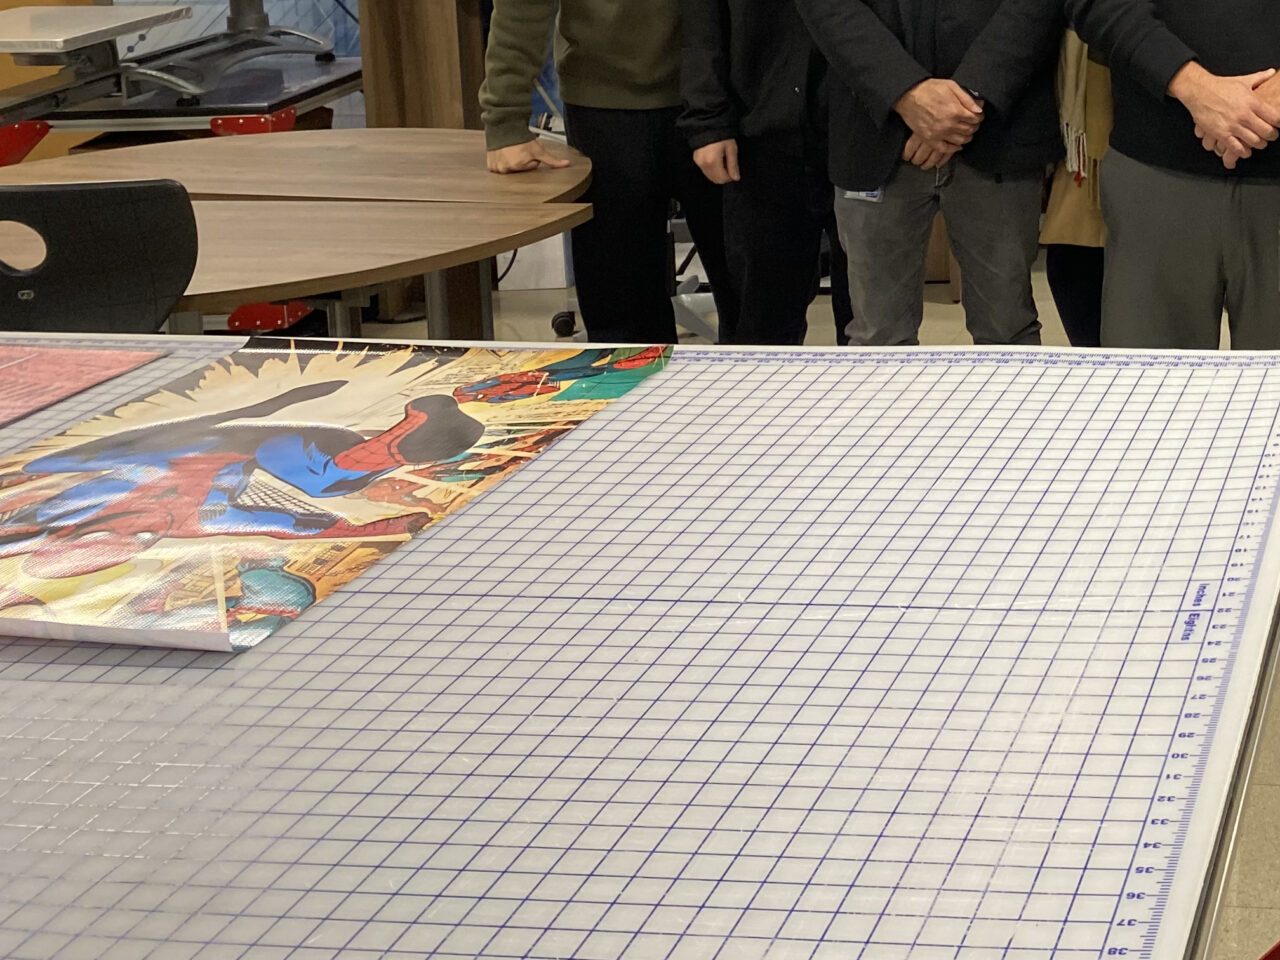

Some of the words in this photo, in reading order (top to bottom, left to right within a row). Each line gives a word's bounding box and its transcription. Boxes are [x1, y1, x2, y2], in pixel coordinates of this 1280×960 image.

[1192, 583, 1211, 607] Inches
[1143, 841, 1162, 849] 34
[1135, 866, 1155, 874] 35
[1126, 892, 1146, 900] 36
[1116, 918, 1138, 926] 37
[1107, 947, 1128, 956] 38
